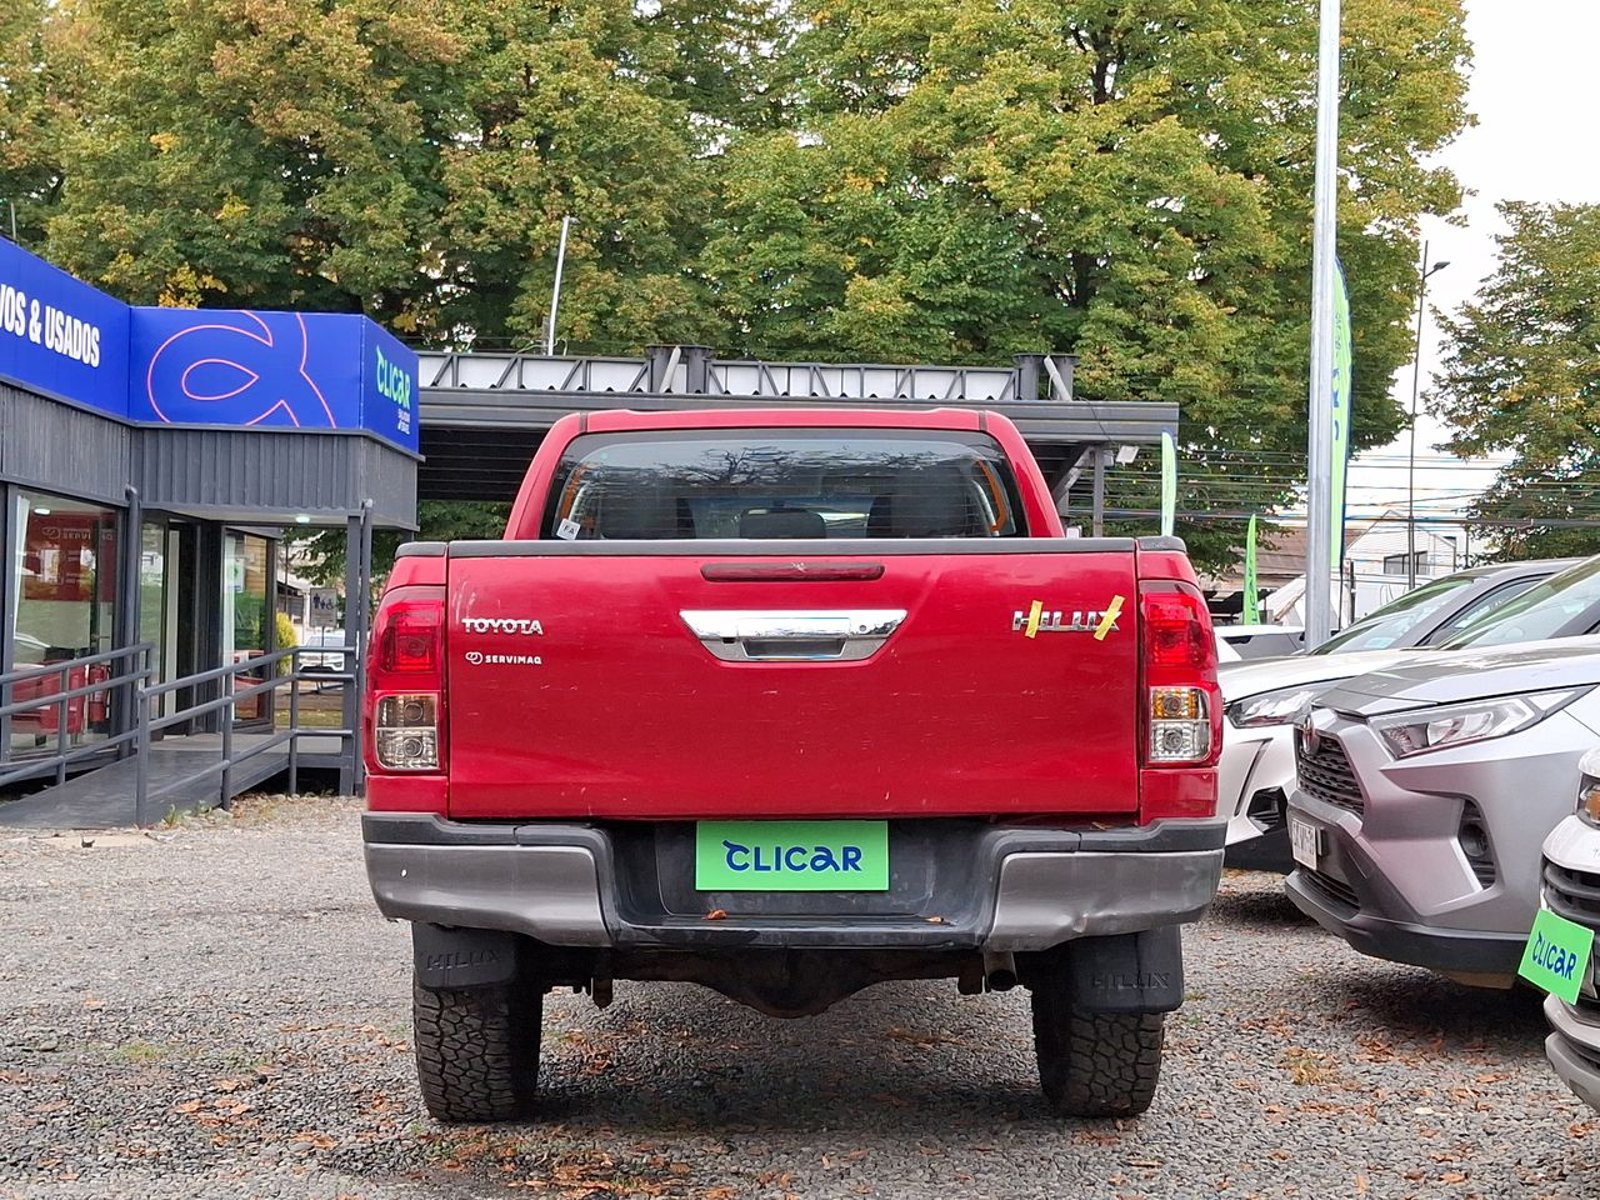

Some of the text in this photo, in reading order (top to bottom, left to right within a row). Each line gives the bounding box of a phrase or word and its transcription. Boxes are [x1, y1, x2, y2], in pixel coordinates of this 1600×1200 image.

[29, 299, 41, 344] &
[45, 305, 100, 367] USADOS
[461, 618, 543, 635] TOYOTA
[485, 655, 542, 665] SERVIMAQ
